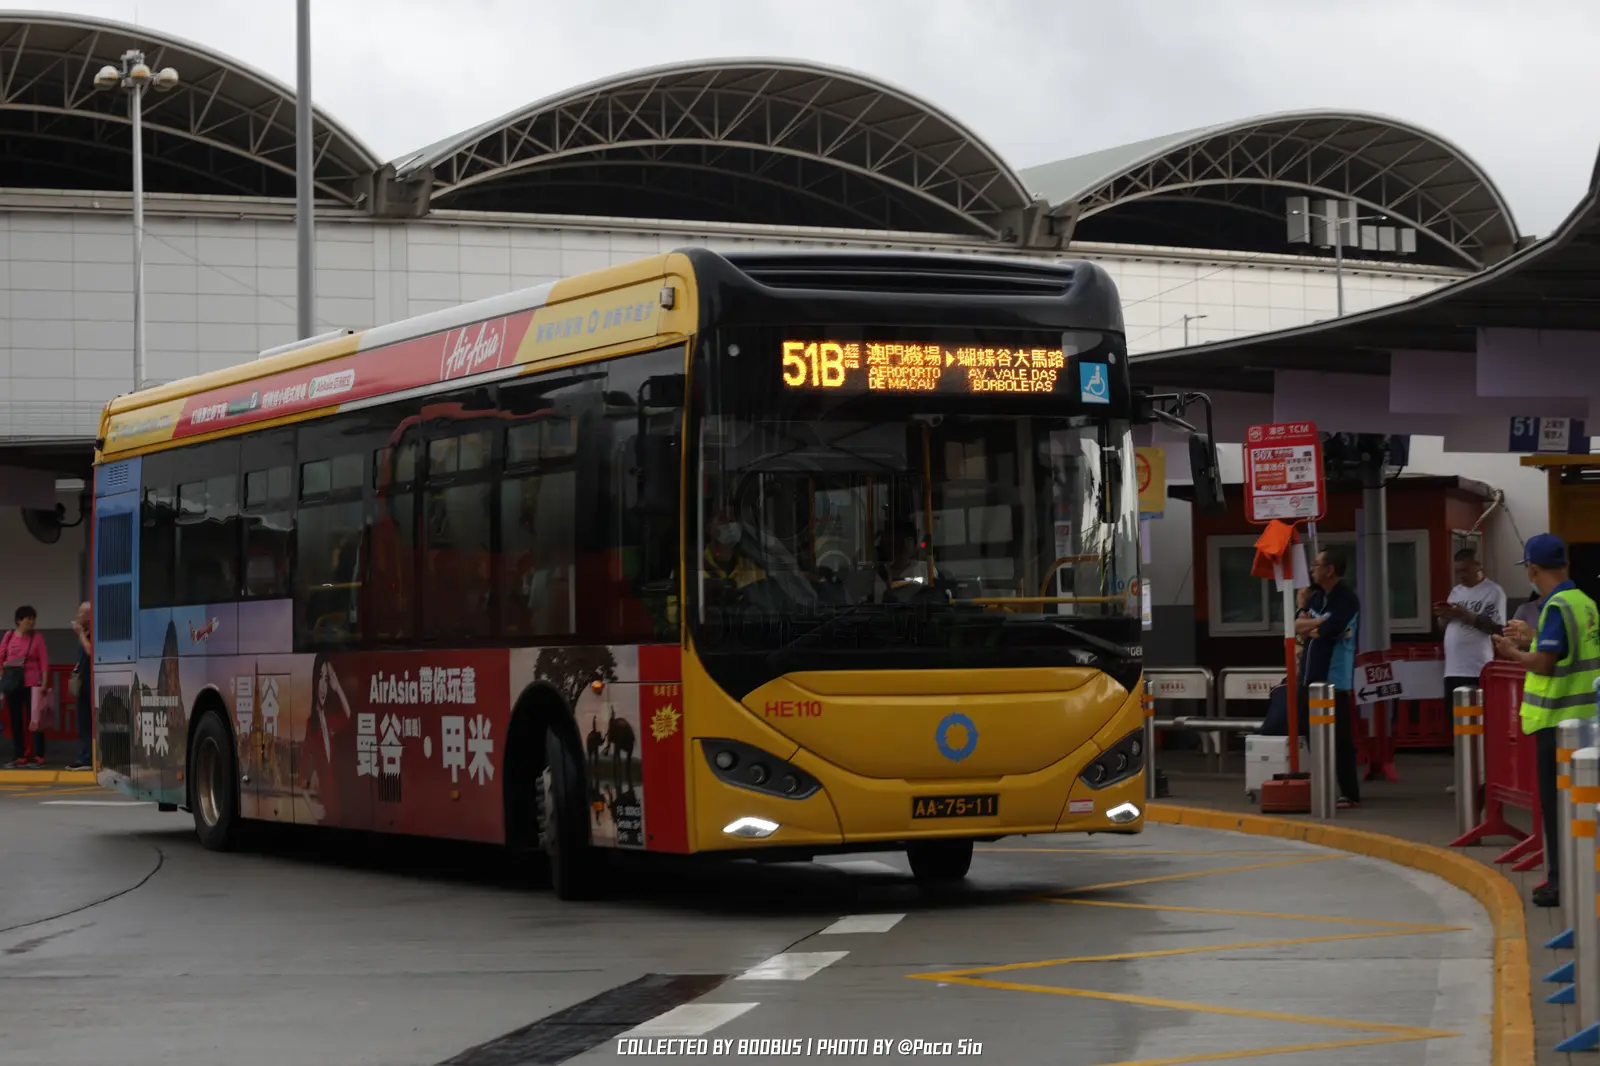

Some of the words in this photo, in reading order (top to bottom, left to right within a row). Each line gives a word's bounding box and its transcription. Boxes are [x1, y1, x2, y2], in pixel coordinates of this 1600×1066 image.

[782, 341, 846, 388] 51B
[866, 343, 942, 367] 澳門機場
[956, 348, 1065, 369] 蝴蝶谷大馬路
[869, 366, 942, 379] AEROPORTO
[968, 368, 990, 380] AV.
[993, 369, 1028, 381] VALE
[1031, 369, 1057, 381] DAS
[869, 377, 886, 390] DE
[888, 377, 936, 390] MACAU
[972, 380, 1053, 392] BORBOLETAS
[1288, 424, 1309, 434] TCM
[1513, 416, 1535, 437] 51
[369, 669, 418, 704] AirAsia
[419, 666, 477, 704] 帶你玩盡
[1367, 667, 1391, 682] 30X
[765, 700, 822, 718] HE110
[141, 710, 169, 757] 甲米
[356, 712, 404, 778] 曼谷
[441, 713, 494, 787] 甲米
[915, 796, 994, 817] AA-75-11
